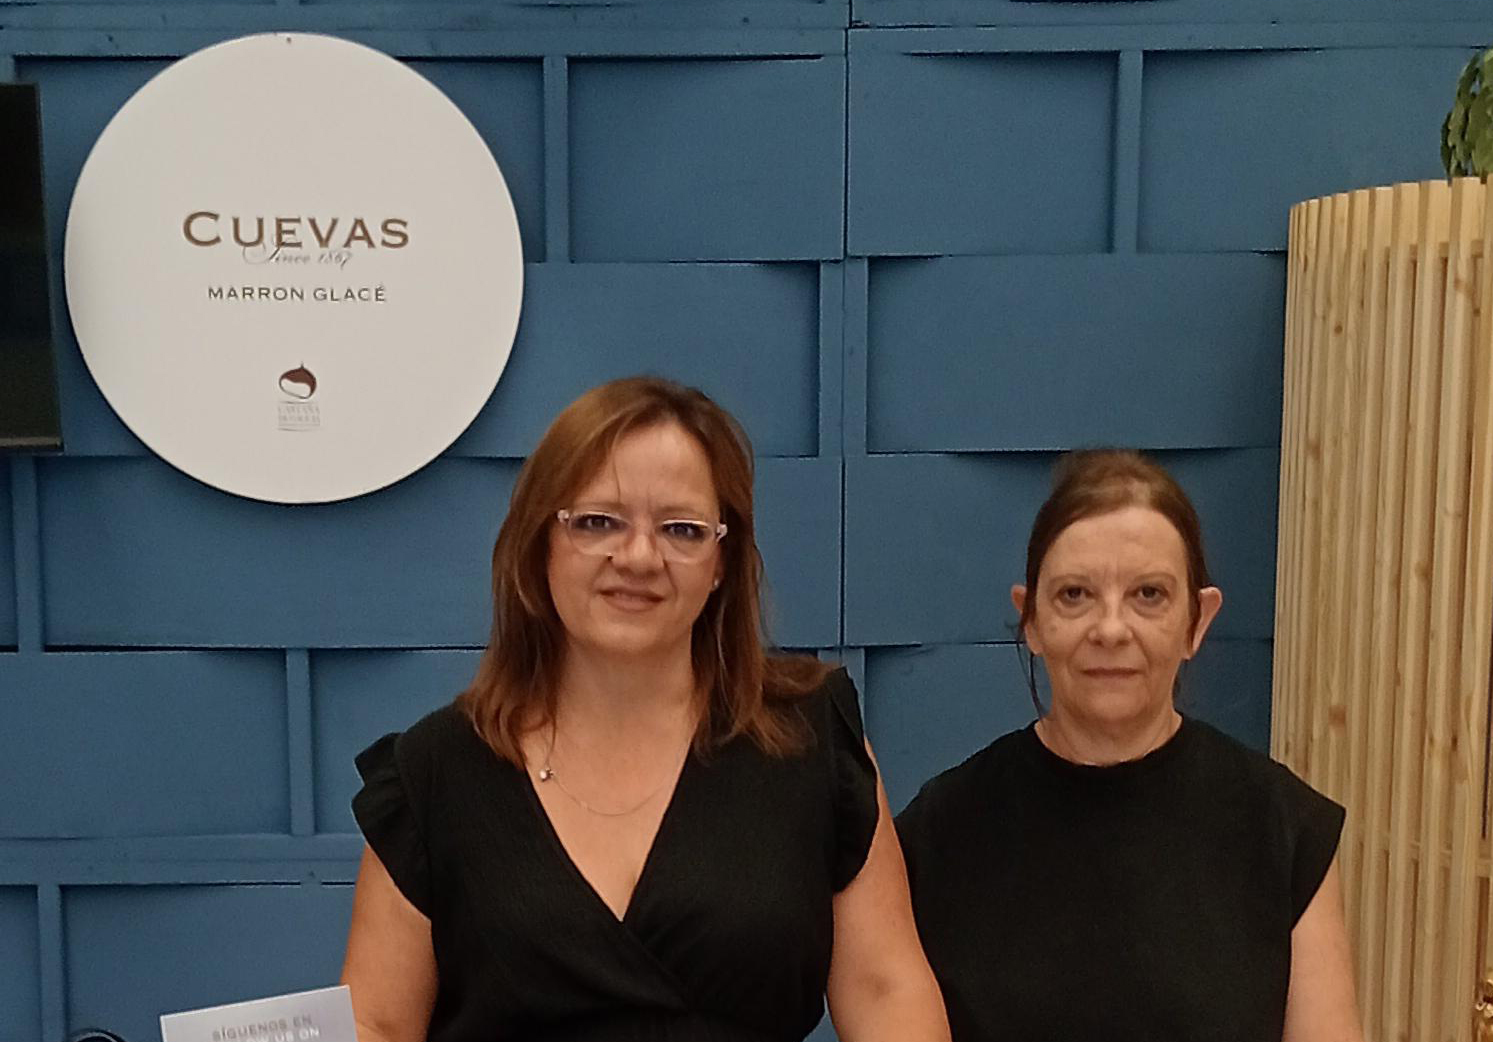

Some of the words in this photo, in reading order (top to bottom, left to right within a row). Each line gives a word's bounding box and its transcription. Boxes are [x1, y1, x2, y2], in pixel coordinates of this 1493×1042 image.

[183, 211, 409, 249] CUEVAS
[208, 287, 304, 301] MARRON
[313, 283, 386, 301] GLACÉ
[299, 1025, 320, 1041] ON
